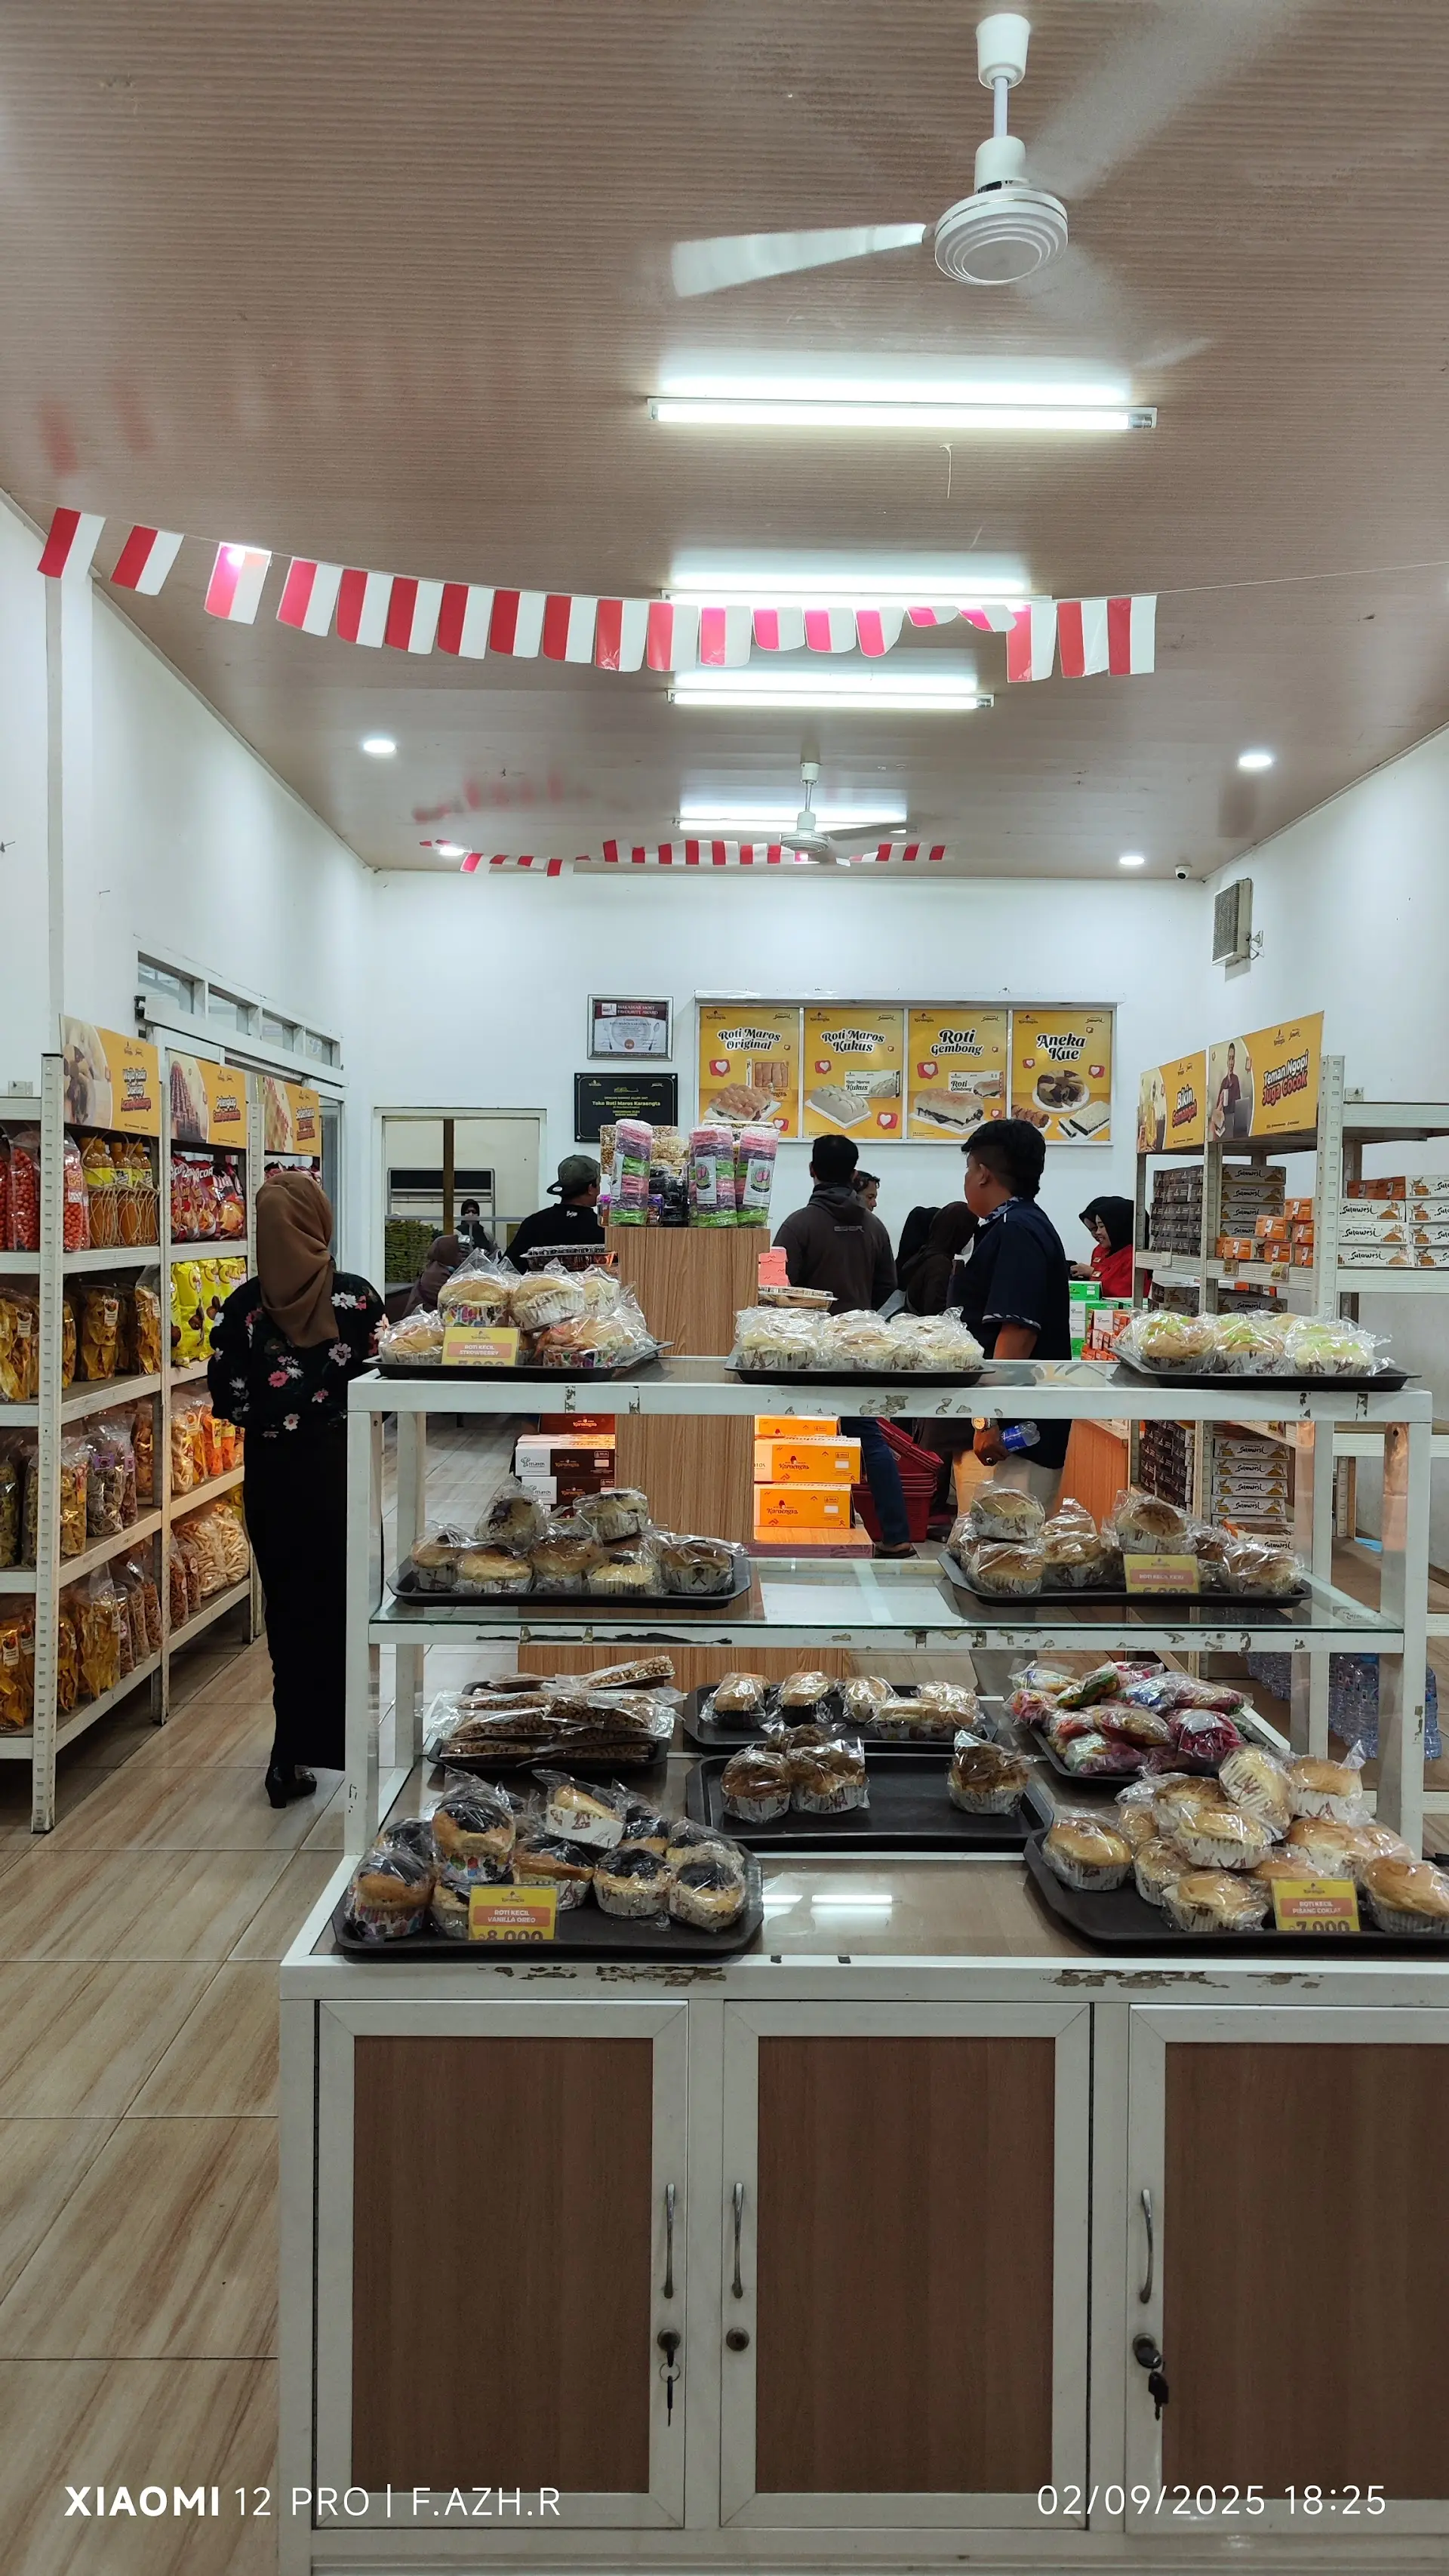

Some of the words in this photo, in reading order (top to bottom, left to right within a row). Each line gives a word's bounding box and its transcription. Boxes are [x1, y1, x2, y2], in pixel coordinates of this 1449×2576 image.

[718, 1028, 742, 1040] Roti
[744, 1028, 781, 1042] Maros
[822, 1029, 845, 1042] Roti
[848, 1029, 884, 1042] Maros
[939, 1029, 976, 1044] Roti
[1037, 1033, 1085, 1048] Aneka
[727, 1039, 772, 1050] Original
[833, 1040, 873, 1052] Kukus
[931, 1043, 983, 1055] Gembong
[1048, 1047, 1079, 1060] Kue
[1263, 1066, 1287, 1087] Teman
[1287, 1049, 1309, 1076] Ngopi
[1263, 1084, 1281, 1106] Juga
[1283, 1069, 1308, 1097] Cocok
[1177, 1085, 1193, 1110] Bikin
[1340, 1205, 1378, 1214] Sulawesi
[1232, 1226, 1255, 1235] Sulawes
[1343, 1228, 1382, 1238] Sulawesi
[1348, 1251, 1387, 1260] Sulawesi
[1296, 1921, 1350, 1931] 7000
[487, 1930, 543, 1940] 8000
